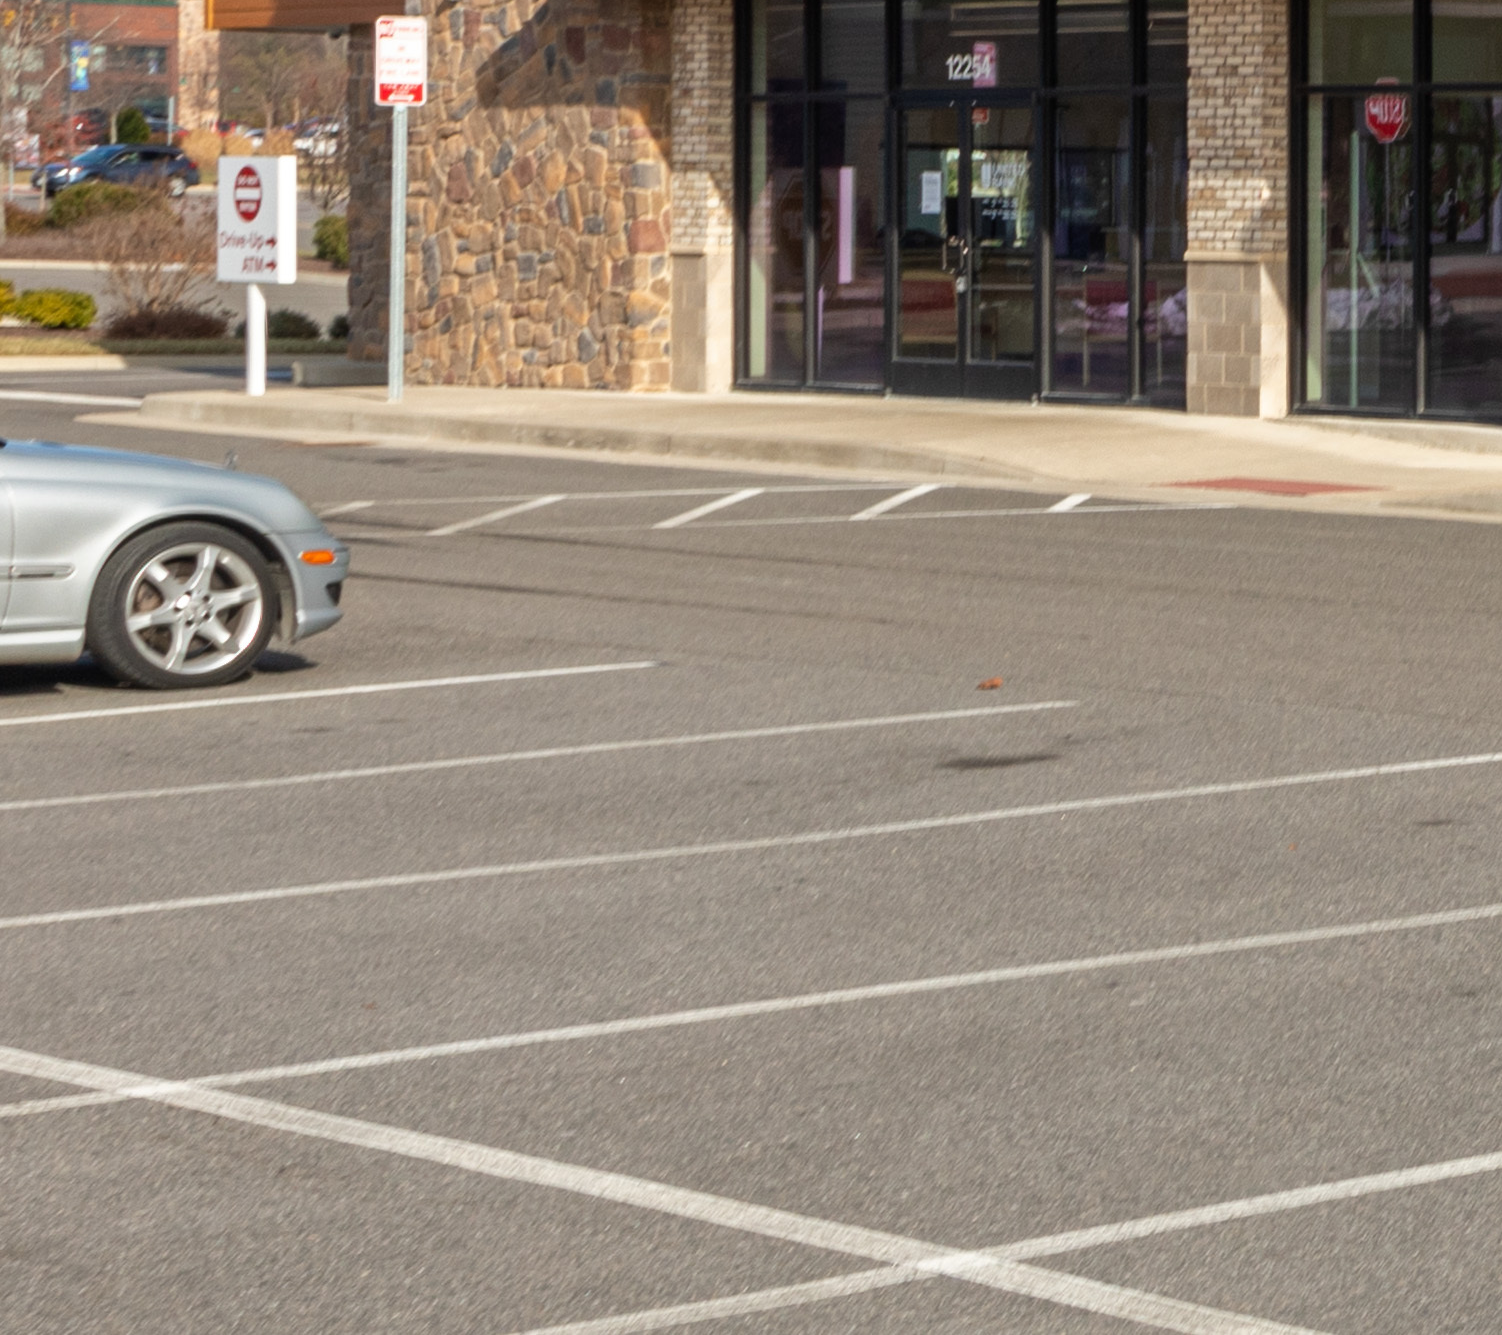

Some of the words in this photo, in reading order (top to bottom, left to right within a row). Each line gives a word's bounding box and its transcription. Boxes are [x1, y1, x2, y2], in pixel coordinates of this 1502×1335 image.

[945, 53, 992, 80] 12254
[219, 231, 264, 252] Drive-Up
[242, 256, 264, 274] ATM
